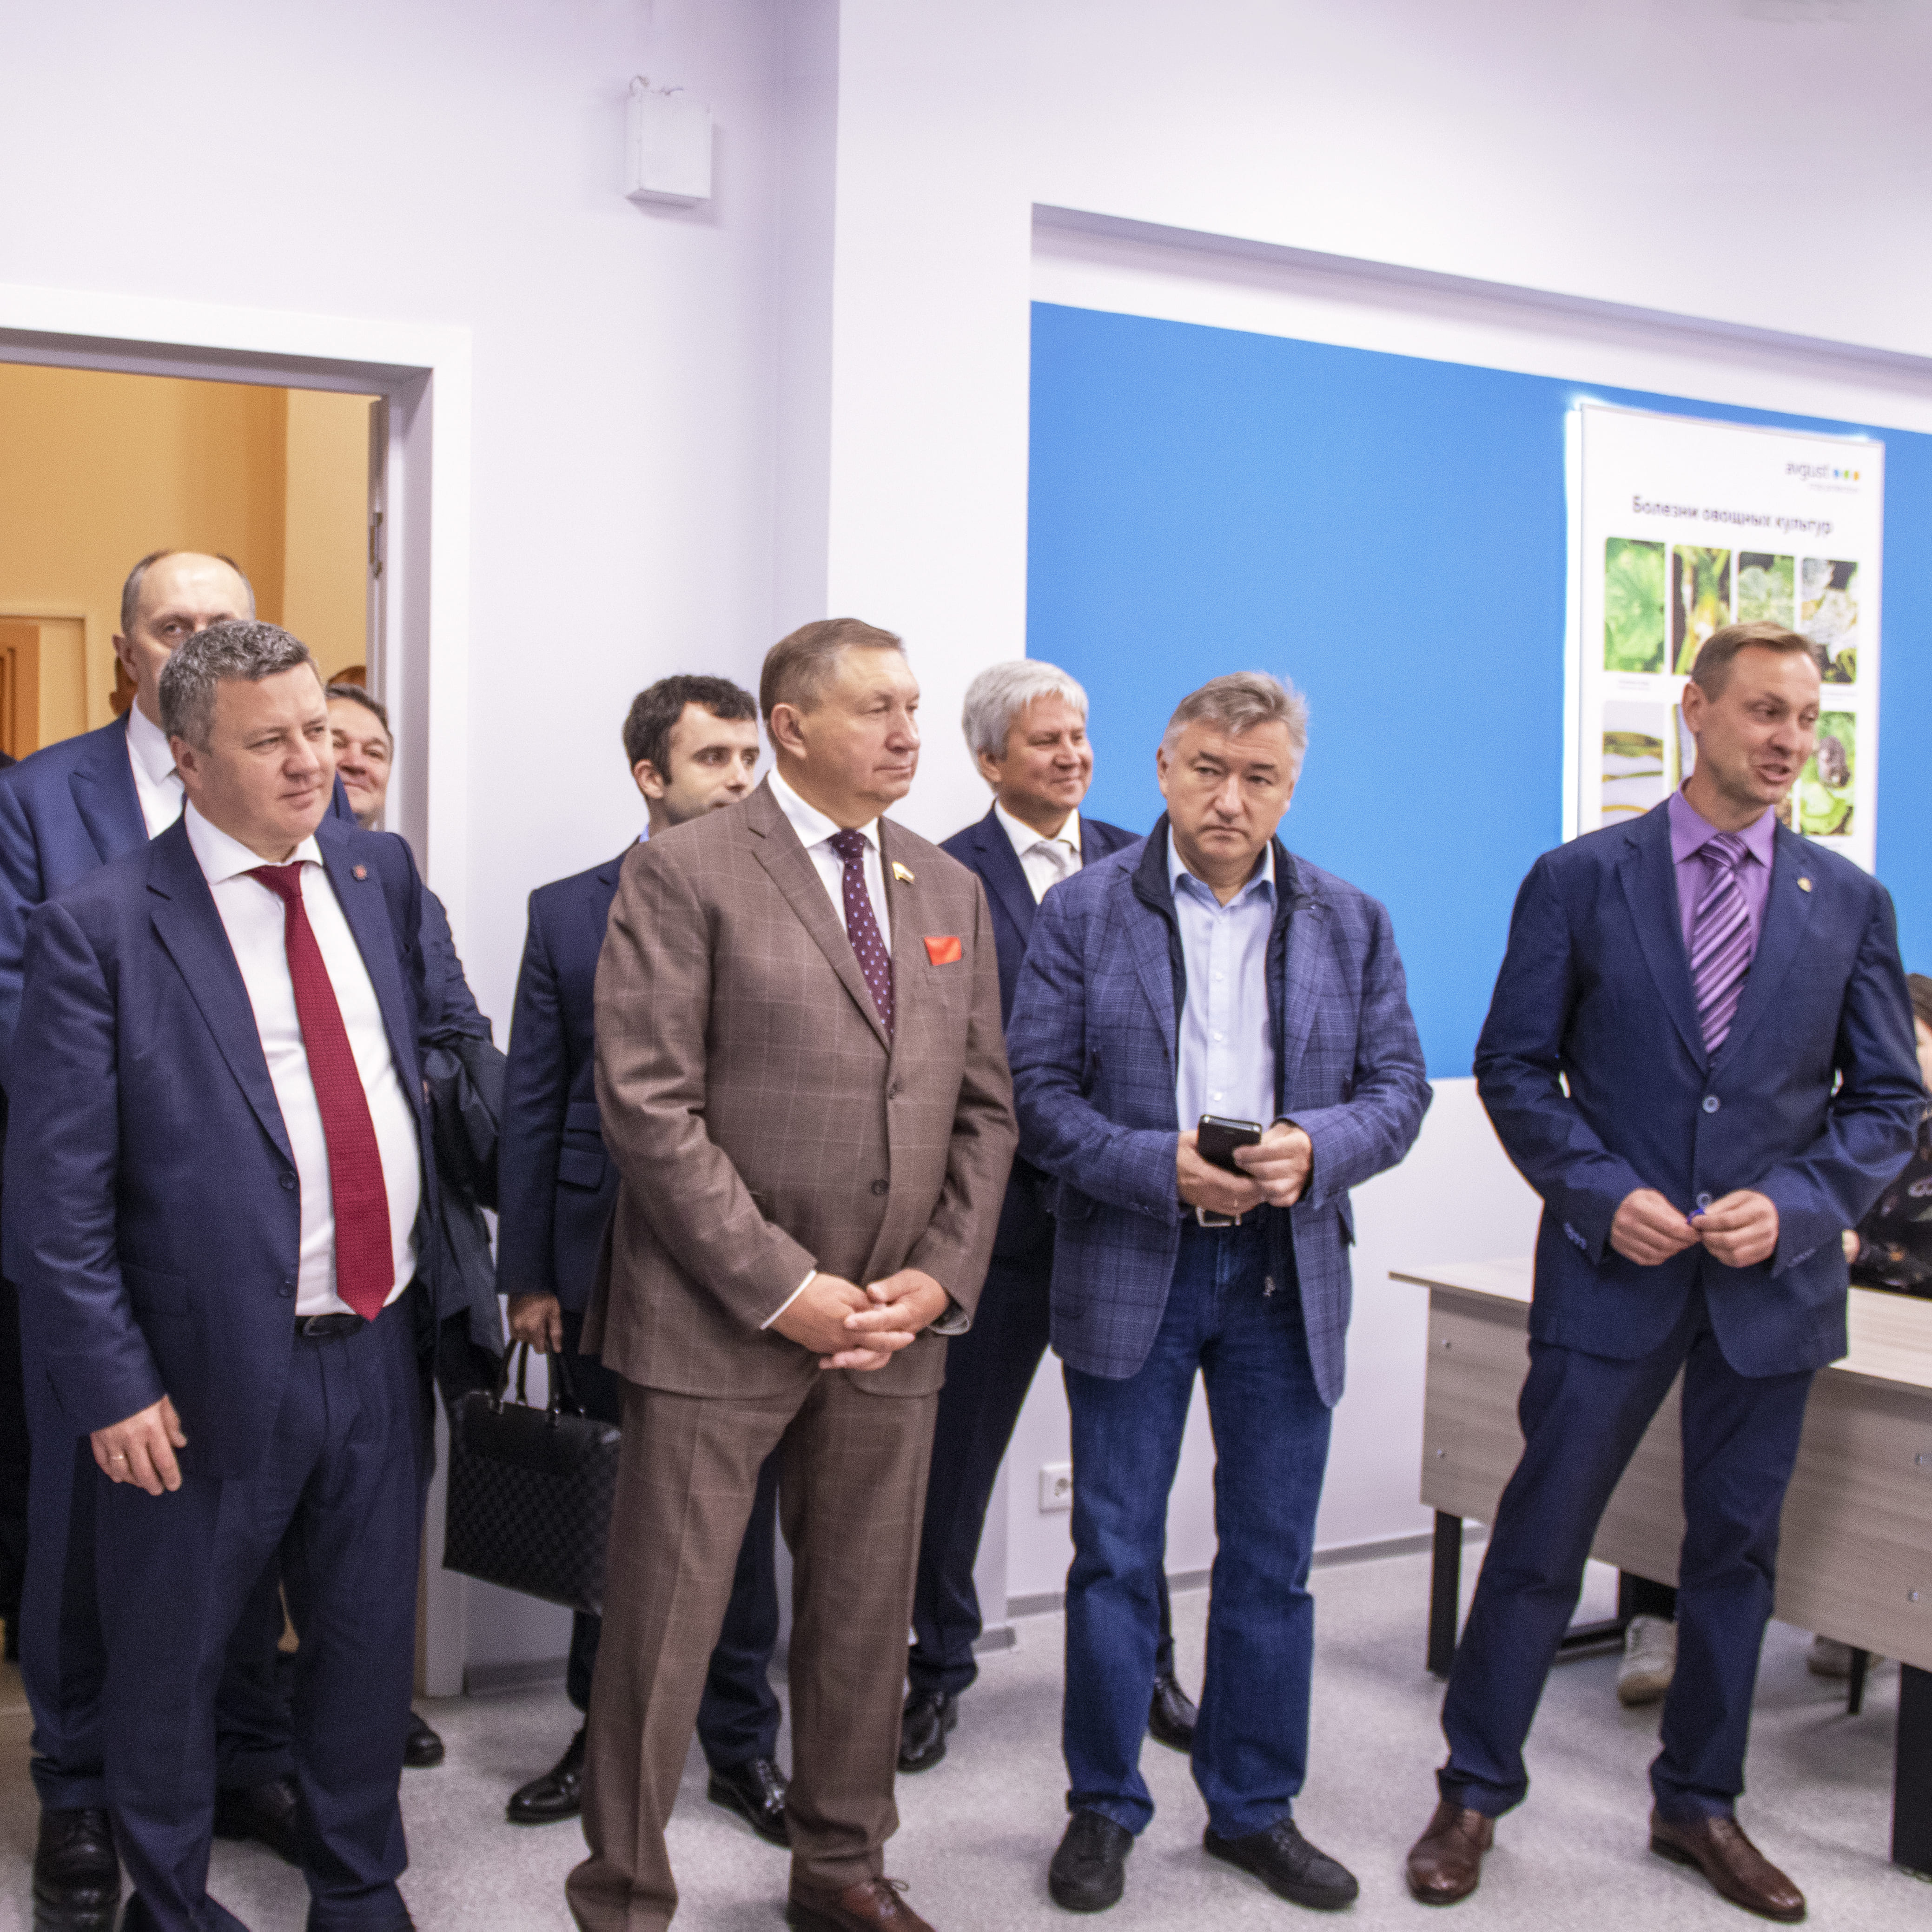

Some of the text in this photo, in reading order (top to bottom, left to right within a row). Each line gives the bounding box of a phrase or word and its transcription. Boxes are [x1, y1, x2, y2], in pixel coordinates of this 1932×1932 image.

[1786, 462, 1828, 481] avgust
[1633, 495, 1833, 538] Болезни овощных культур
